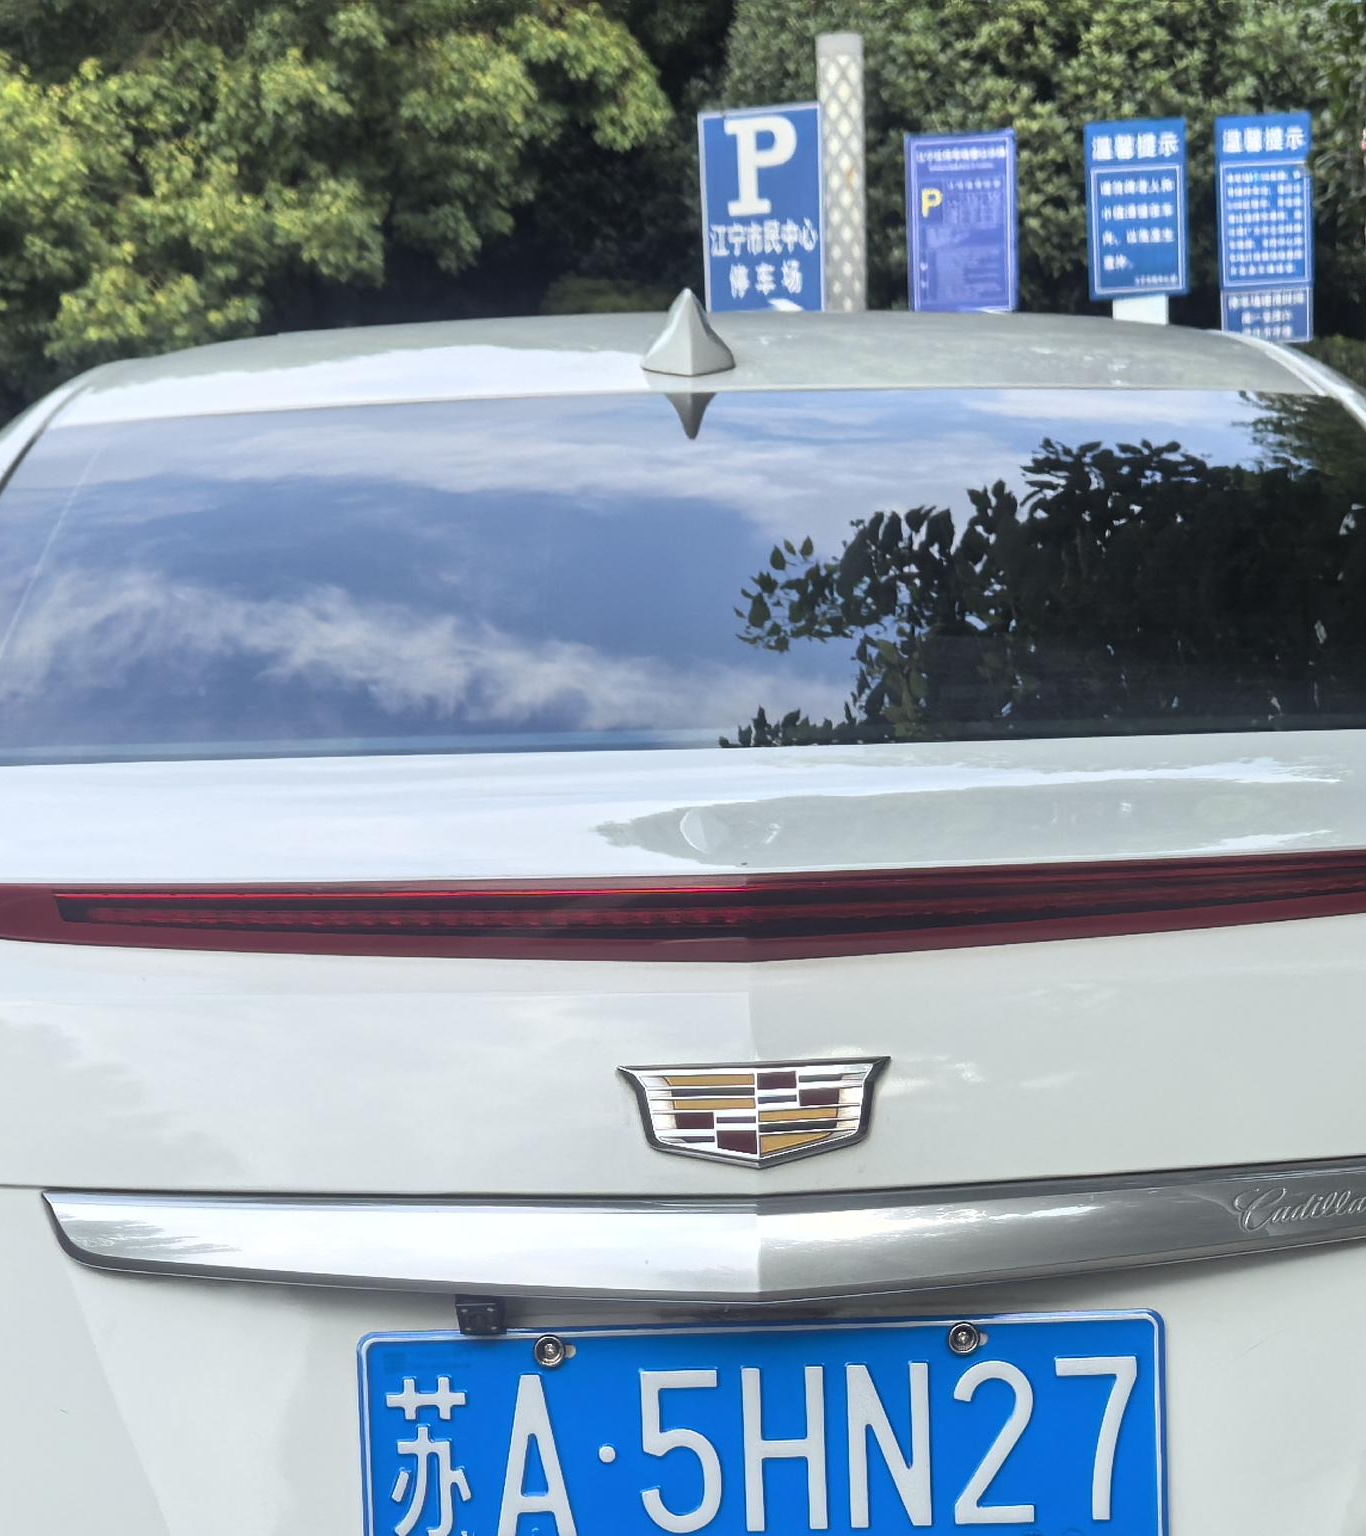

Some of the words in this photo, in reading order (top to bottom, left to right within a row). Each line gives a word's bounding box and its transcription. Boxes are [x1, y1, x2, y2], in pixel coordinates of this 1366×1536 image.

[724, 114, 798, 217] P
[921, 187, 943, 218] P
[710, 217, 819, 257] 江宁市民中心
